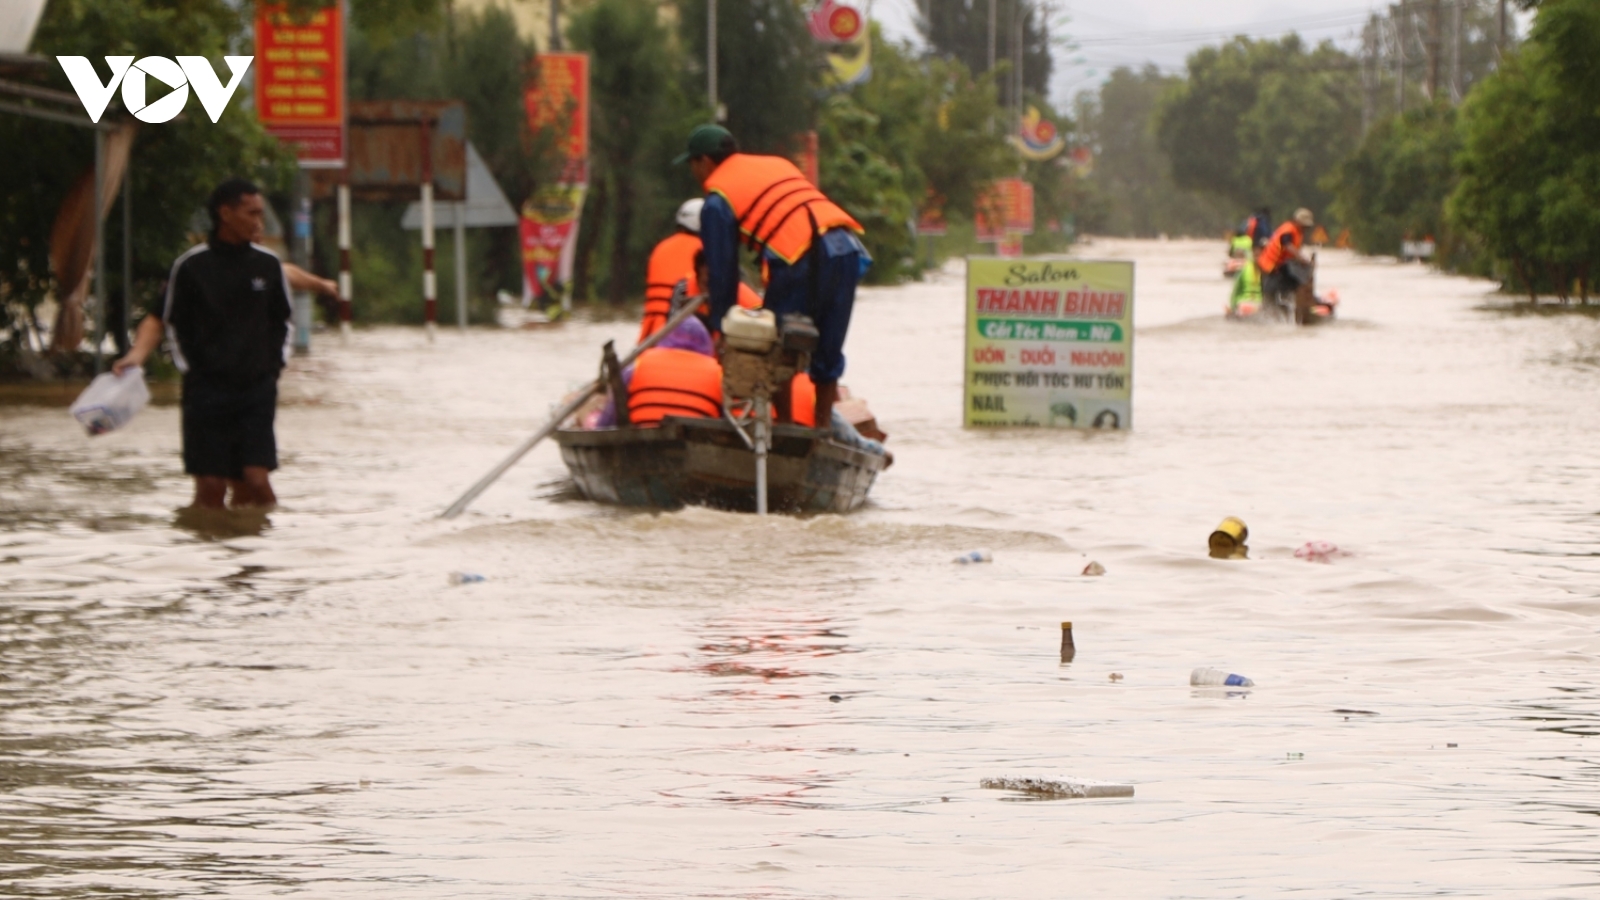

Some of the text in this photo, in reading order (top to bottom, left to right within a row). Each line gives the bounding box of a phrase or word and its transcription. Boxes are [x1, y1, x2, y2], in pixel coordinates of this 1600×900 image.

[1004, 263, 1080, 287] Salon
[976, 284, 1125, 318] THANH BÌNH
[1015, 322, 1041, 339] Tóc
[1043, 324, 1078, 340] Nam
[973, 371, 1011, 388] PHỤC
[1043, 372, 1070, 388] TÓC
[972, 395, 1006, 412] NAIL
